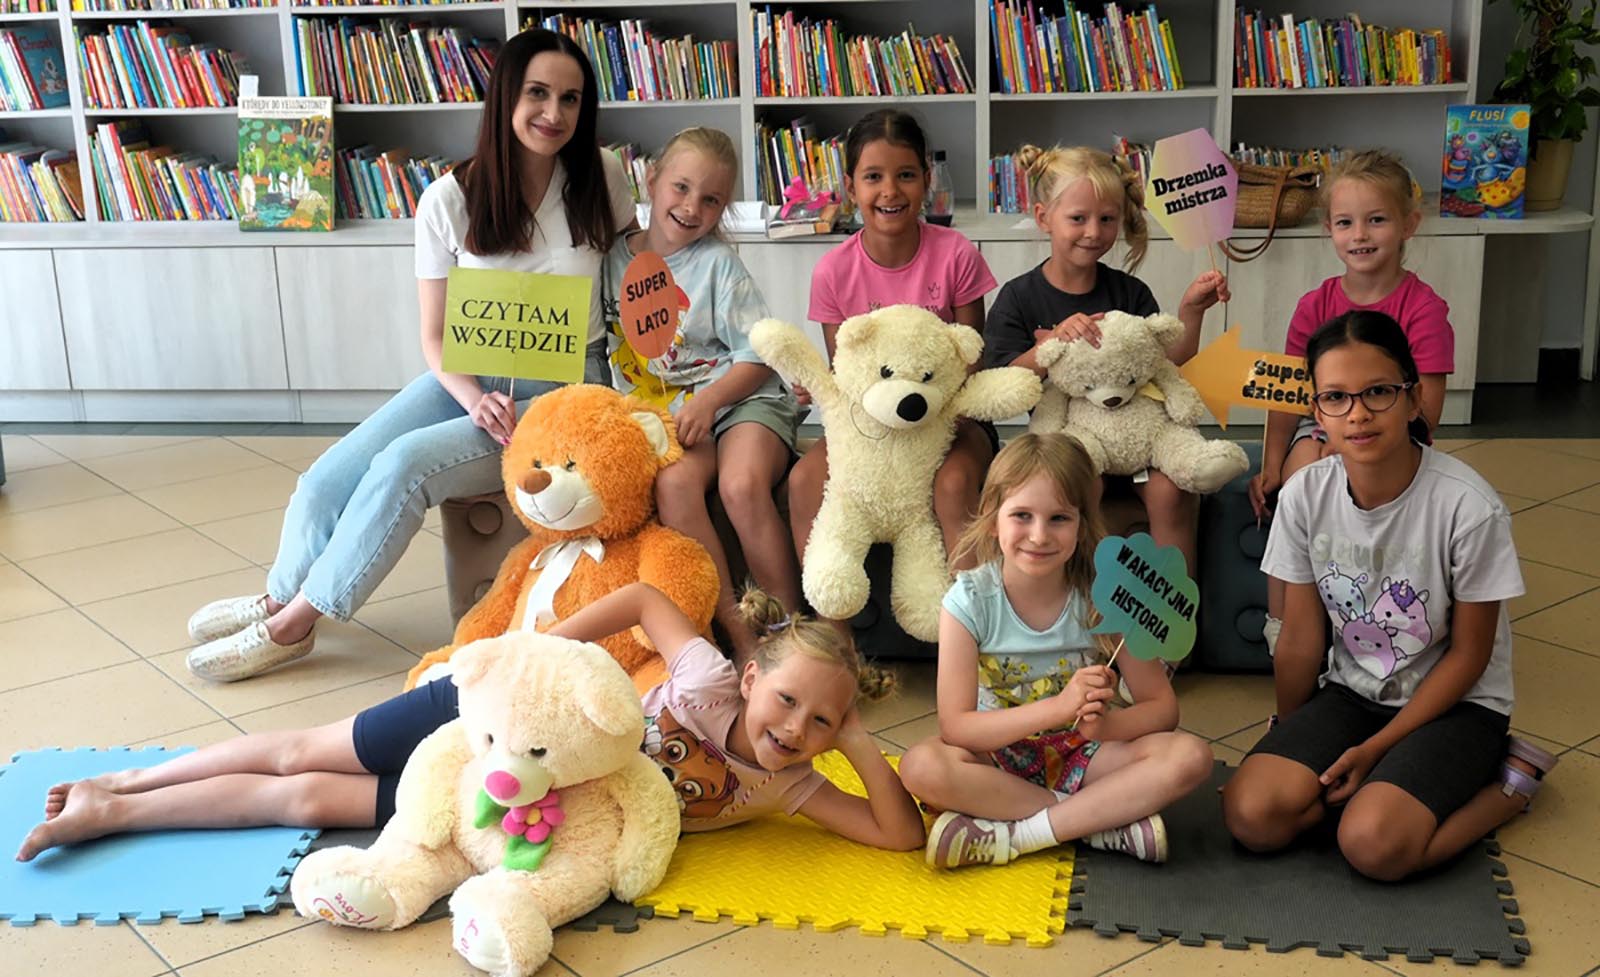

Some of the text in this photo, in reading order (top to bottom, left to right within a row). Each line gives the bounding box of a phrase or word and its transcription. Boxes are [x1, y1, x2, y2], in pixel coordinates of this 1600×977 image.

[271, 99, 281, 109] DO
[1152, 163, 1228, 197] Drzemka
[1164, 185, 1228, 215] mistrza
[626, 270, 668, 302] SUPER
[461, 299, 570, 326] CZYTAM
[635, 308, 669, 336] LATO
[451, 325, 578, 354] WSZĘDZIE
[1242, 380, 1310, 406] dzieck
[1116, 544, 1195, 622] WAKACYJNA
[1110, 584, 1170, 644] HISTORIA
